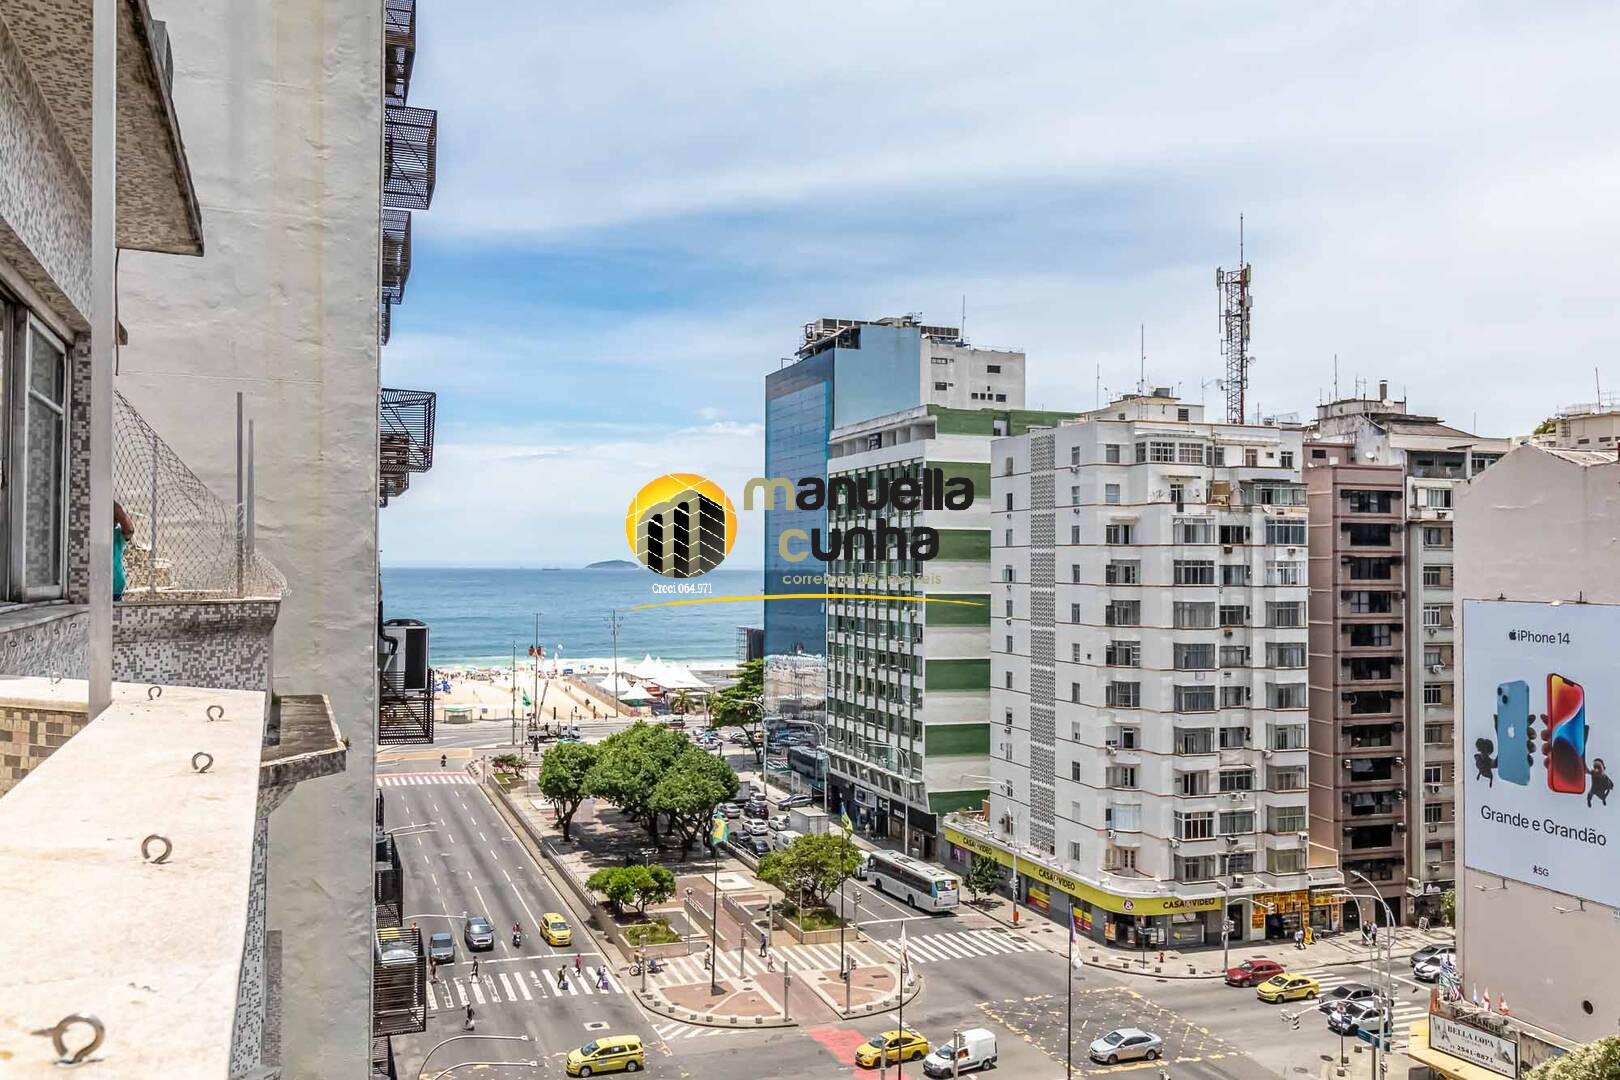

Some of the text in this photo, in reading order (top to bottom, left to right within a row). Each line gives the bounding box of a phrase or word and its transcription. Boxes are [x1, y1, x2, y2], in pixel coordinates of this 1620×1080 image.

[1517, 629, 1570, 645] iPhone 14
[1480, 805, 1607, 847] Grande e Grandão
[1538, 867, 1550, 877] 5G
